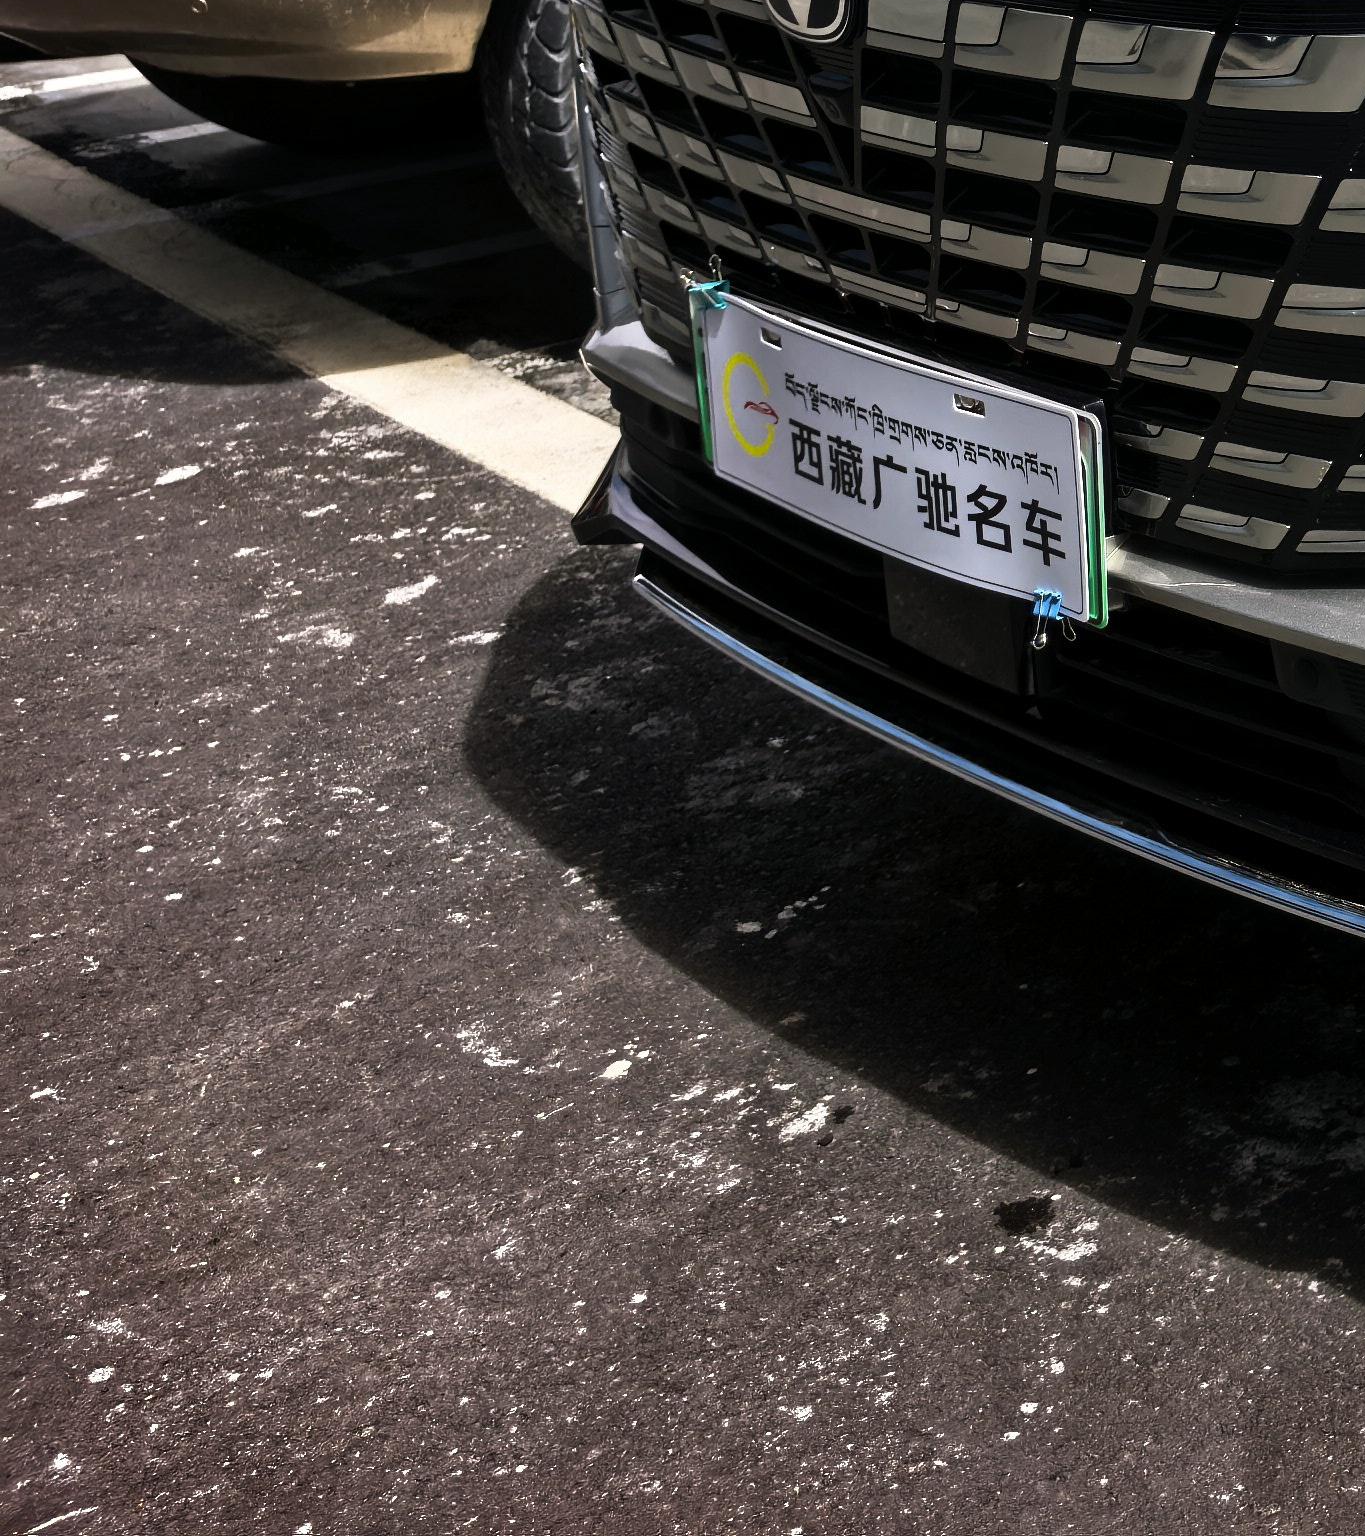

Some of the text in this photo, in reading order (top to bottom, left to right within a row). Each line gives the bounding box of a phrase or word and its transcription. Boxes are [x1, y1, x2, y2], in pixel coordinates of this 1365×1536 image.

[788, 417, 1067, 567] 西藏广驰名车
